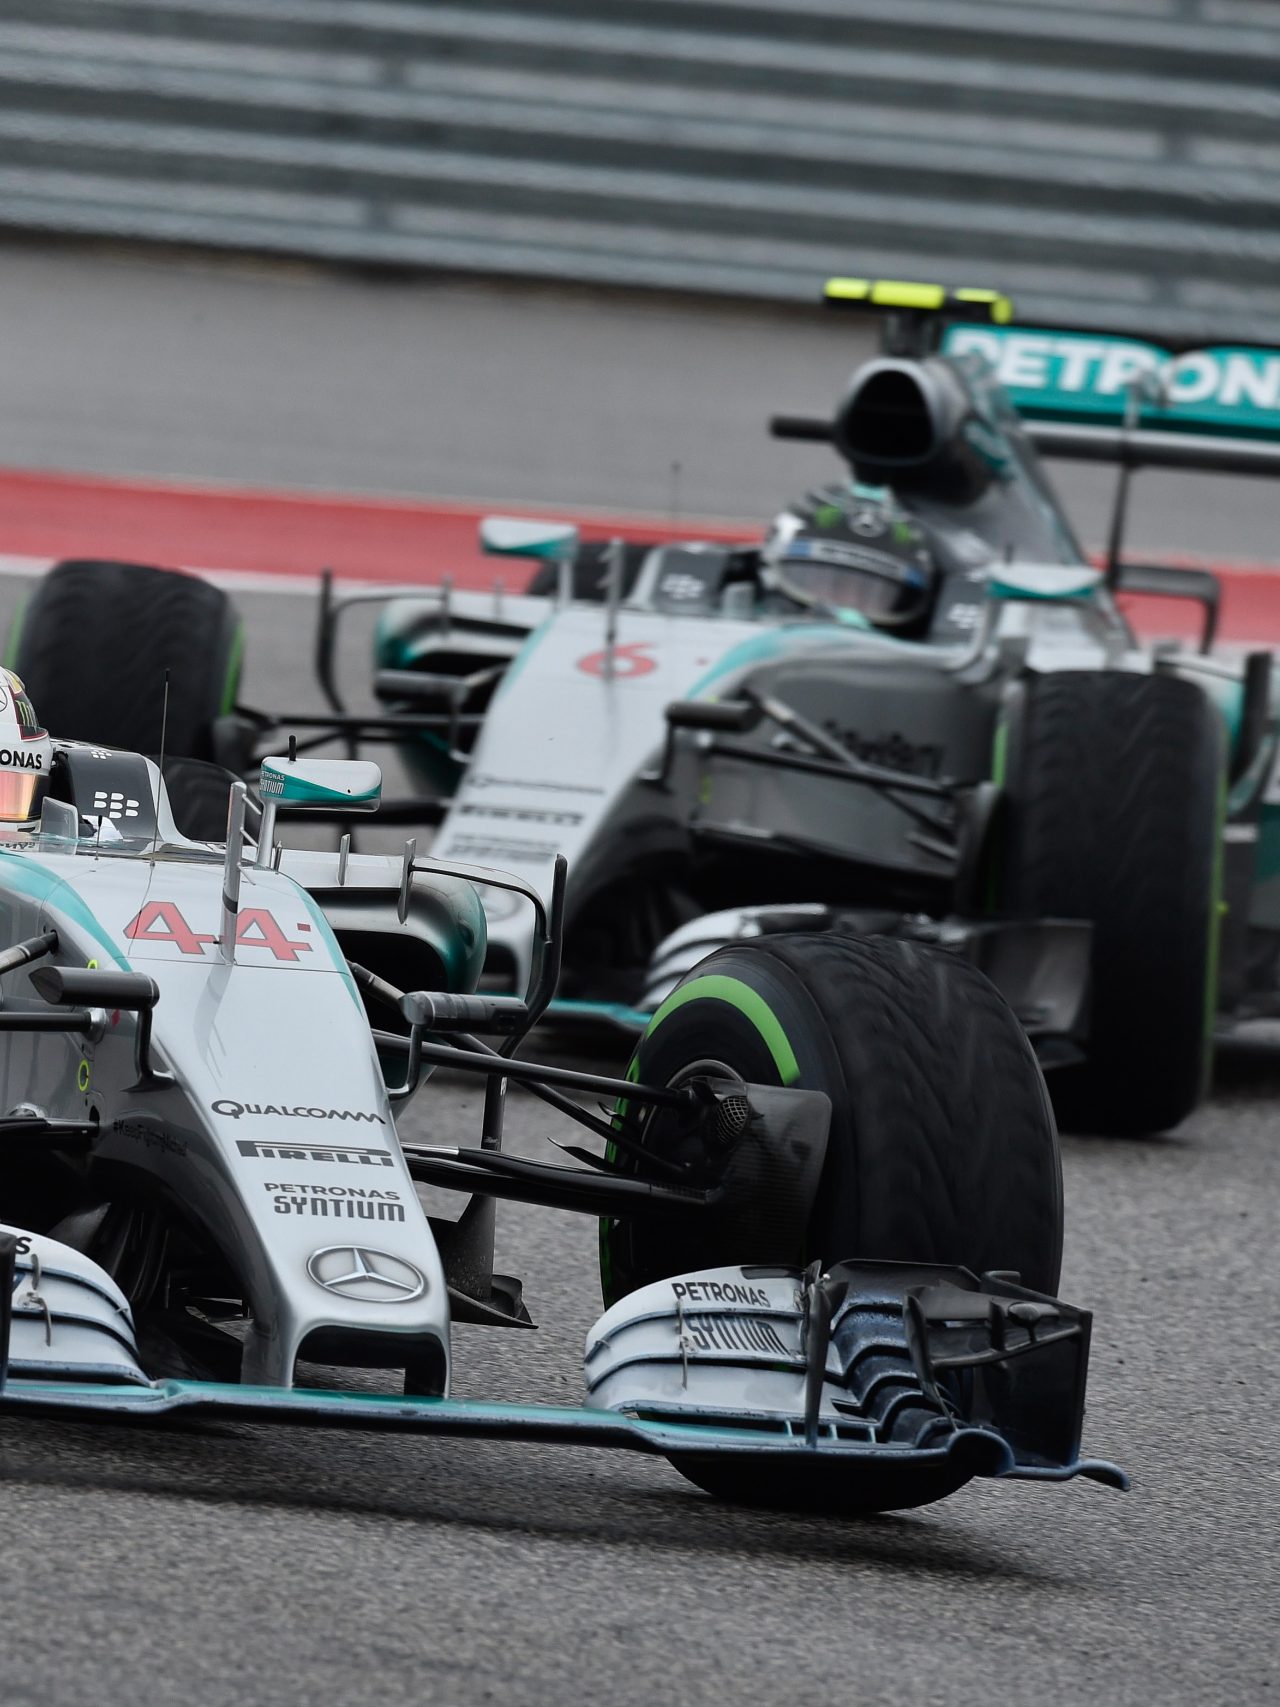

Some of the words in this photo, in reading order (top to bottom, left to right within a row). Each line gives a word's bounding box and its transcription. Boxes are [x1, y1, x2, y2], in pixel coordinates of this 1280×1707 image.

[576, 641, 658, 680] 6
[123, 901, 314, 962] 44
[235, 1140, 395, 1167] PIRELLI
[264, 1183, 401, 1200] PETRONAS
[274, 1196, 405, 1222] SYNTIUM
[671, 1282, 771, 1308] PETRONAS
